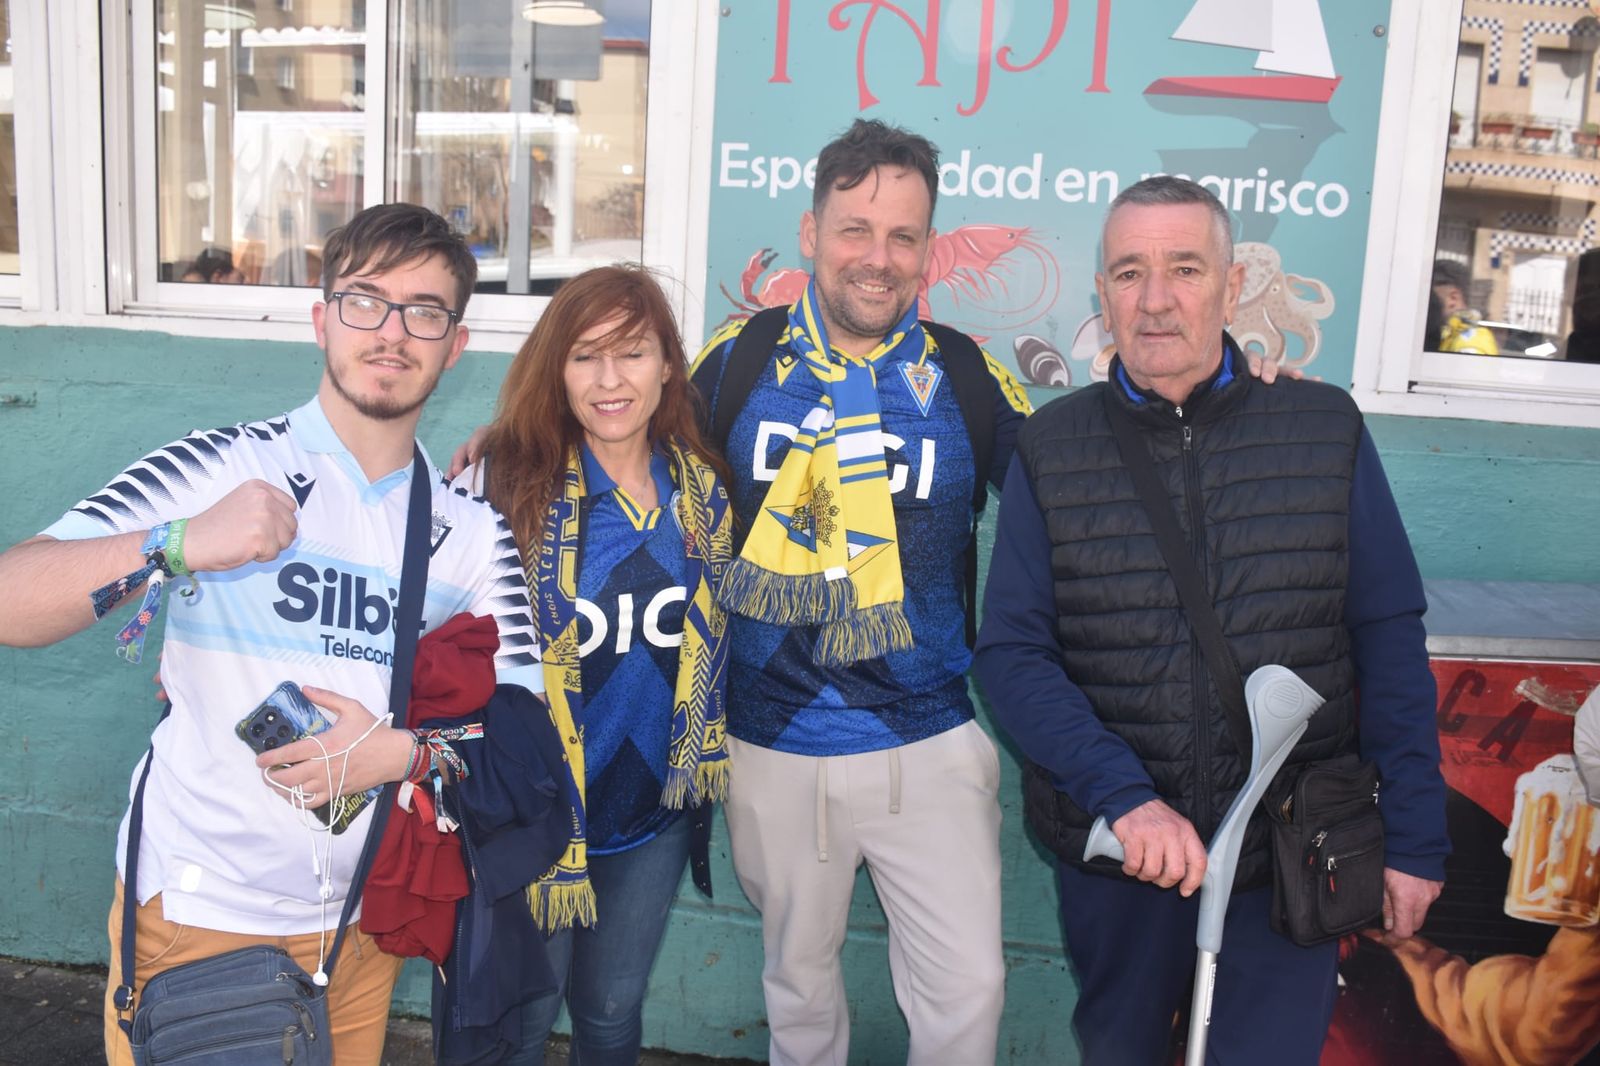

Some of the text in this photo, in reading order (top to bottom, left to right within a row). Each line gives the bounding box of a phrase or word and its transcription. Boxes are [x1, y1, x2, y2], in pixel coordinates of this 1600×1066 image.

[718, 141, 1350, 218] Espedad en arisco
[753, 420, 936, 500] DGI
